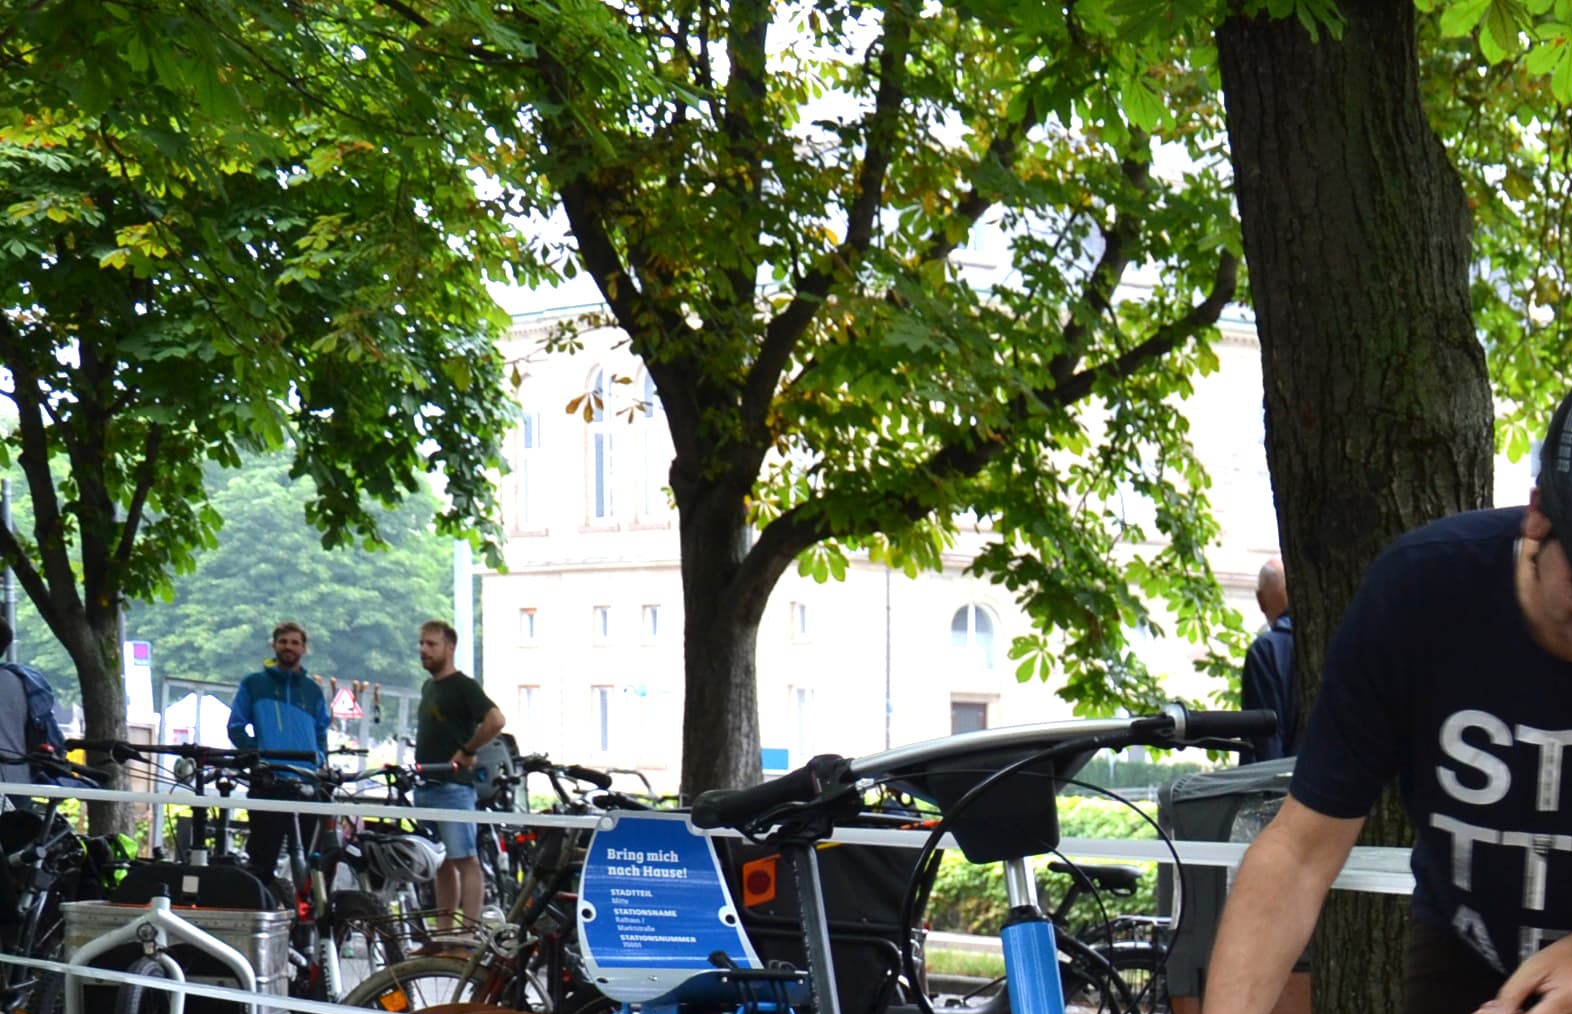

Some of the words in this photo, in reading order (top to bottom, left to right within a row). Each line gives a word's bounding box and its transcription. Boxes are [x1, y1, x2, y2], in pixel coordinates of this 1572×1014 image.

[607, 848, 644, 864] Bring
[646, 850, 679, 862] mich
[608, 864, 640, 876] nach
[643, 866, 688, 878] Hause!
[610, 889, 653, 897] STADTTEIL
[613, 908, 678, 917] STATIONSNAME
[620, 934, 697, 943] STATIONSNUMMER
